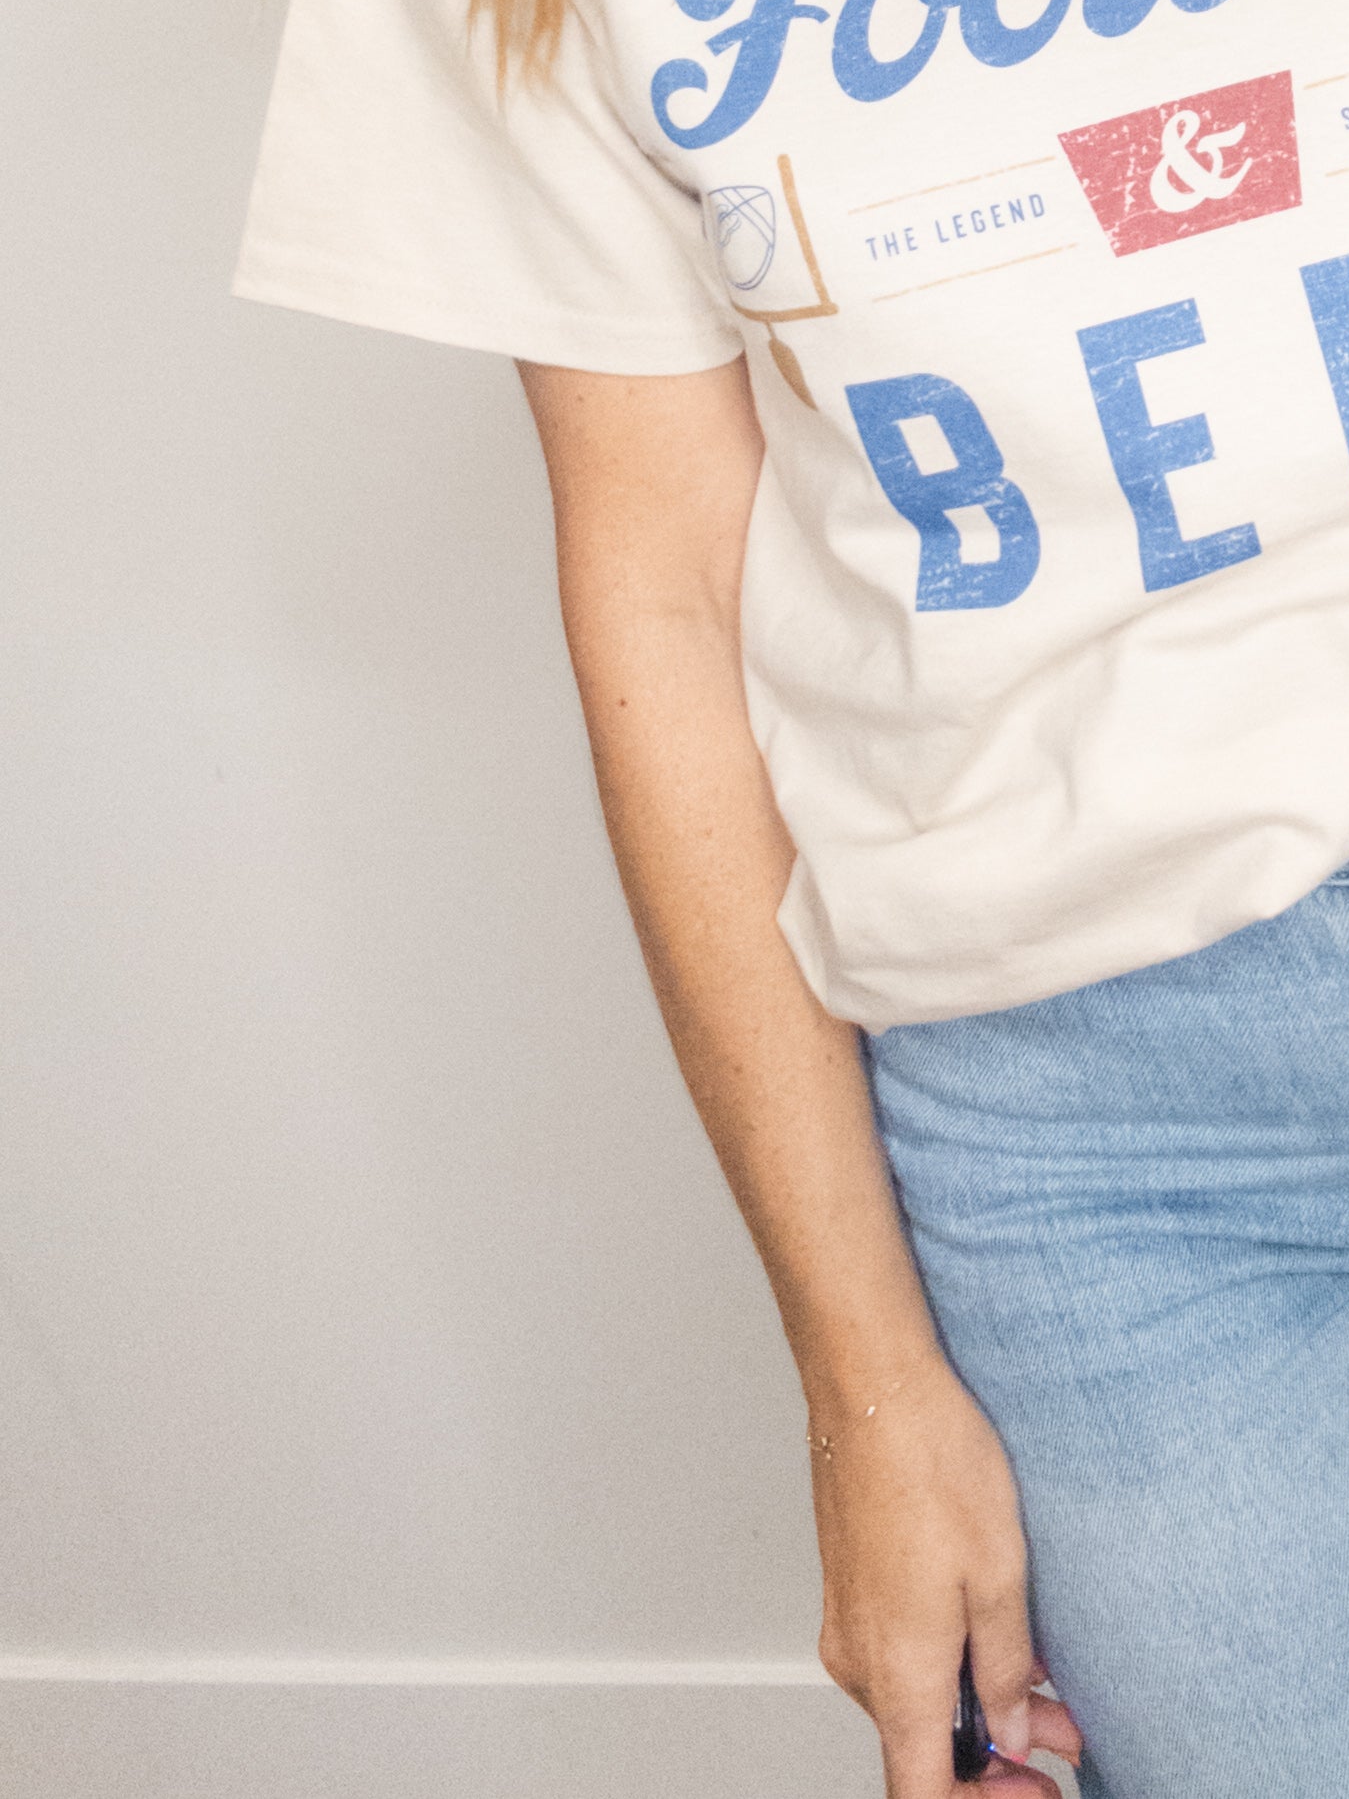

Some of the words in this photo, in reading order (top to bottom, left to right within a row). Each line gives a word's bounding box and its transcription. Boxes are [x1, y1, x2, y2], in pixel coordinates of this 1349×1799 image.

[1148, 109, 1253, 215] &
[865, 226, 919, 262] THE
[934, 192, 1047, 244] LEGEND
